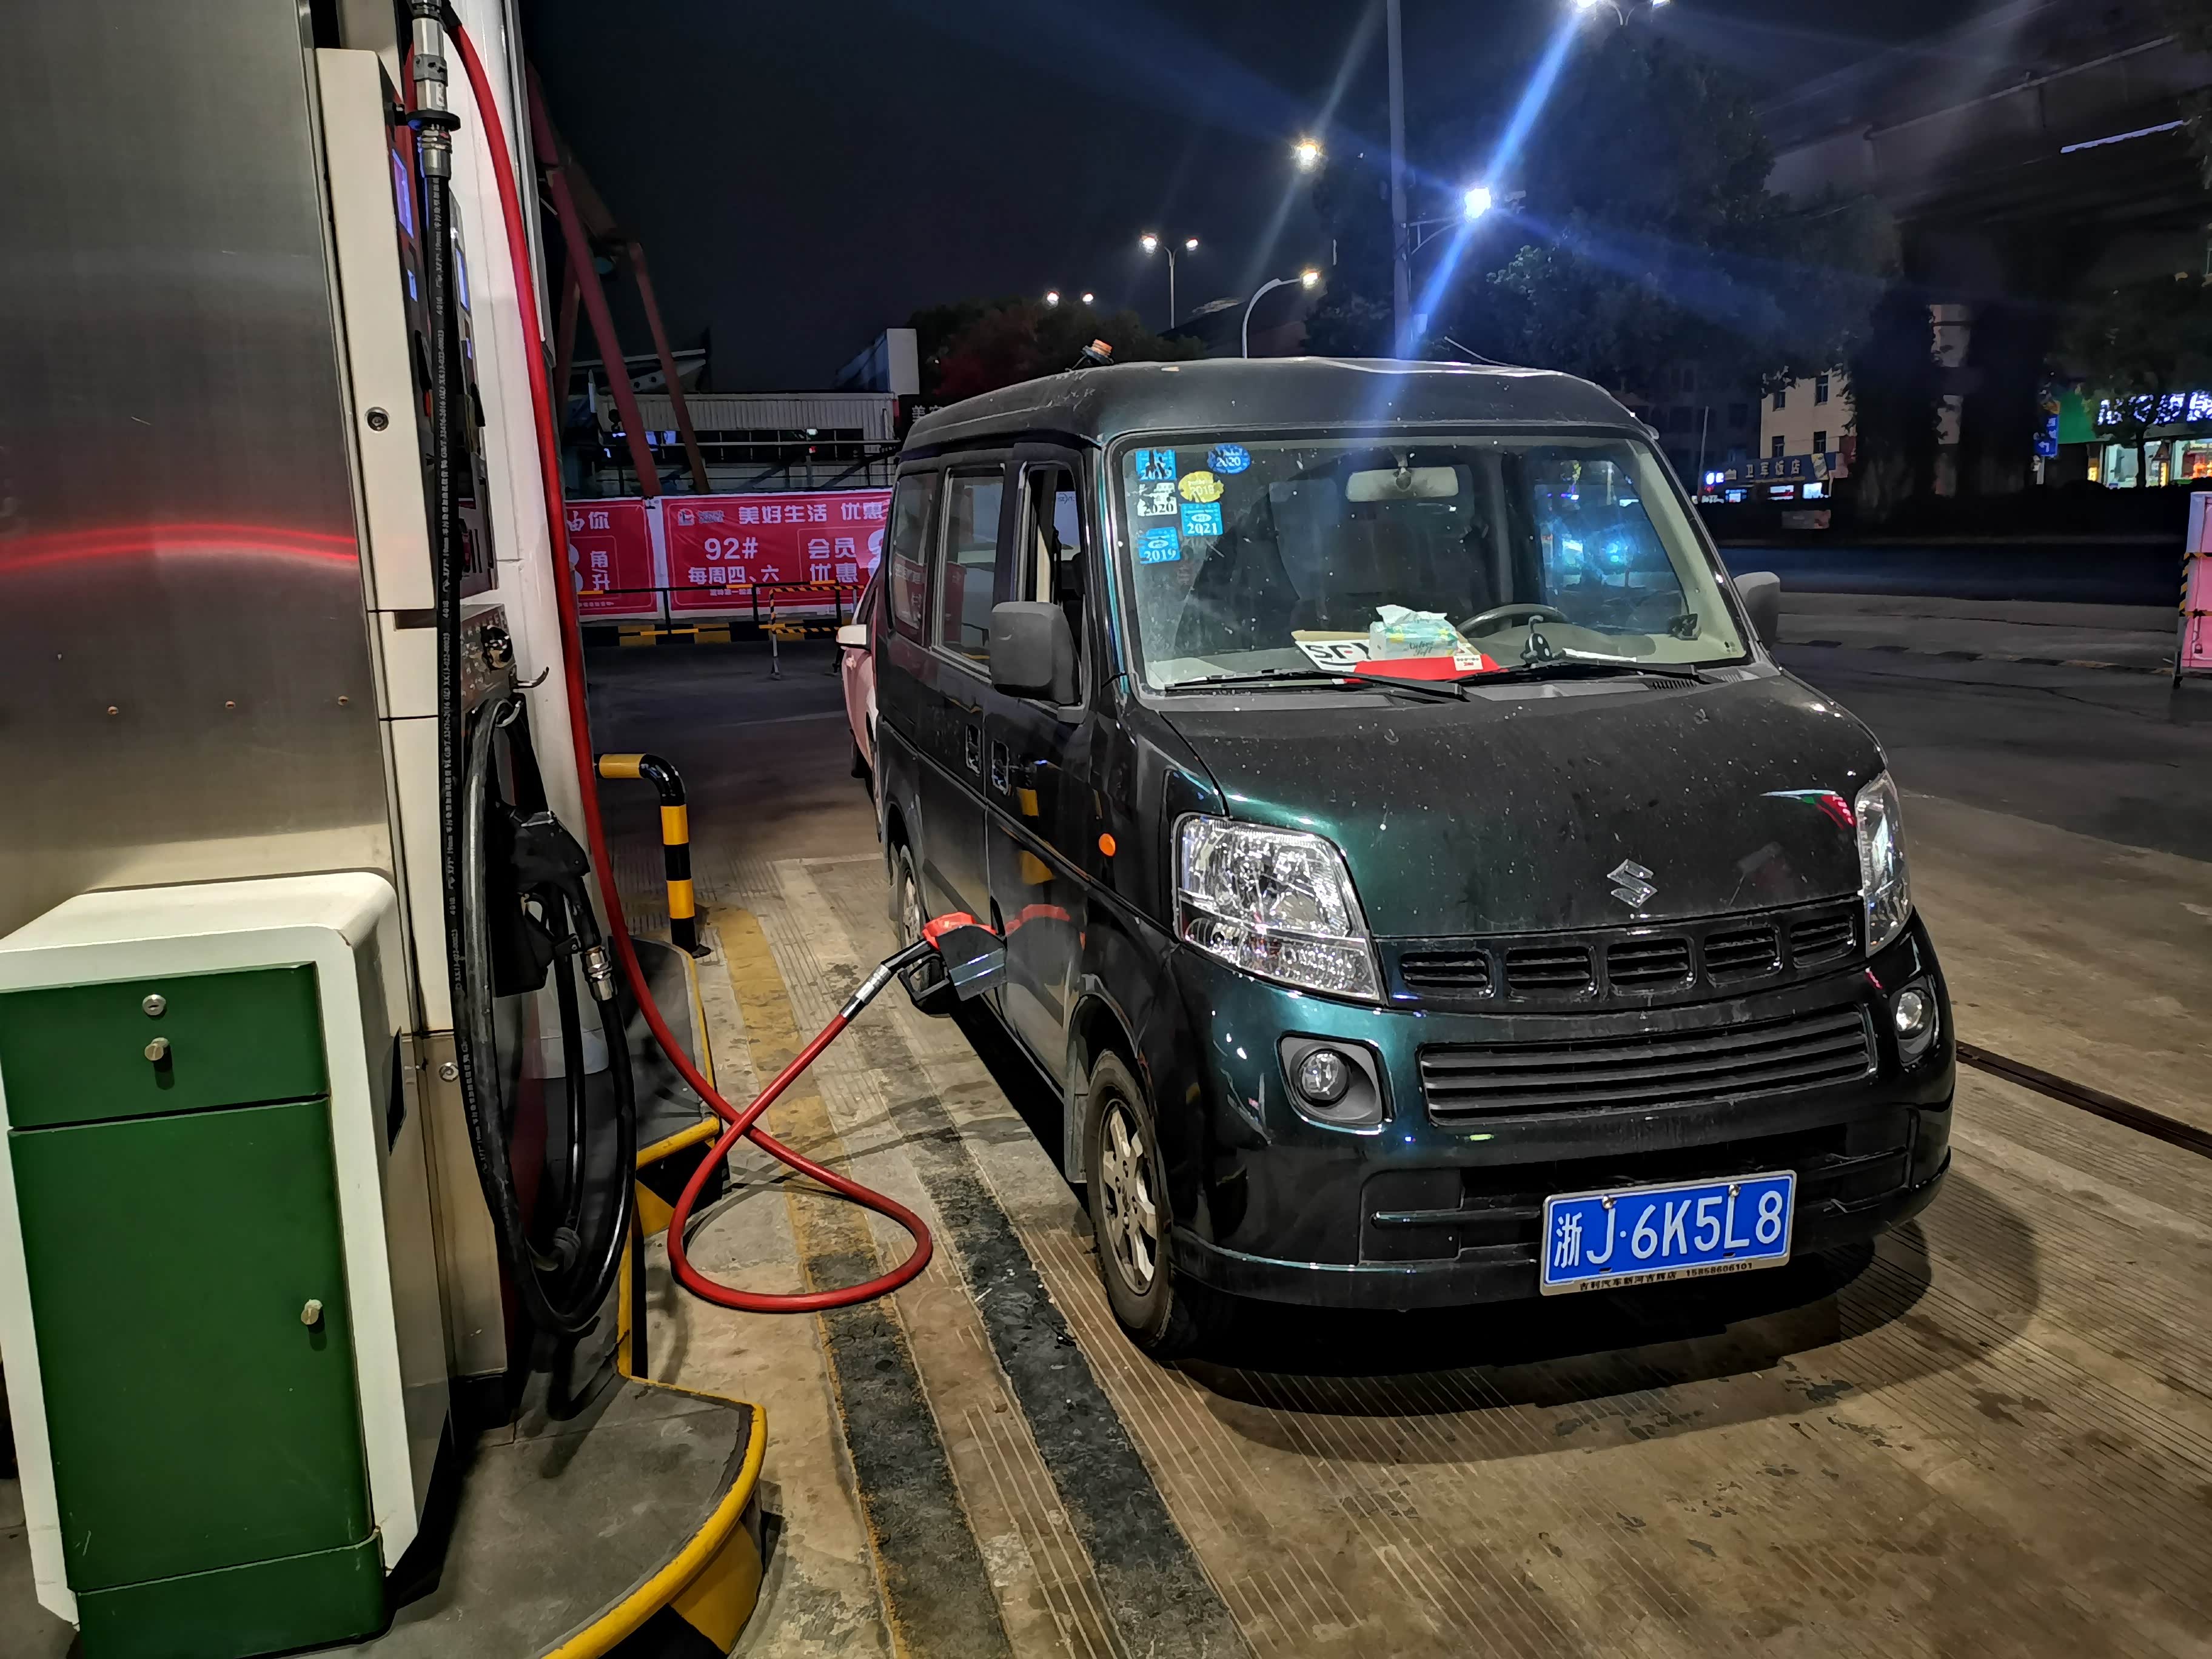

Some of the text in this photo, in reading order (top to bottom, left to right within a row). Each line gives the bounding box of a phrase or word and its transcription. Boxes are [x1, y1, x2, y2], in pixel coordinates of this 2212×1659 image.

[739, 504, 827, 525] 美好生活
[1143, 503, 1175, 514] 2020
[1187, 522, 1218, 536] 2021
[704, 537, 759, 560] 92#
[808, 537, 856, 558] 会员
[1144, 548, 1177, 561] 2019
[688, 565, 779, 585] 每周四、六
[809, 563, 859, 583] 优惠
[1553, 1190, 1783, 1269] 浙J·6K5L8
